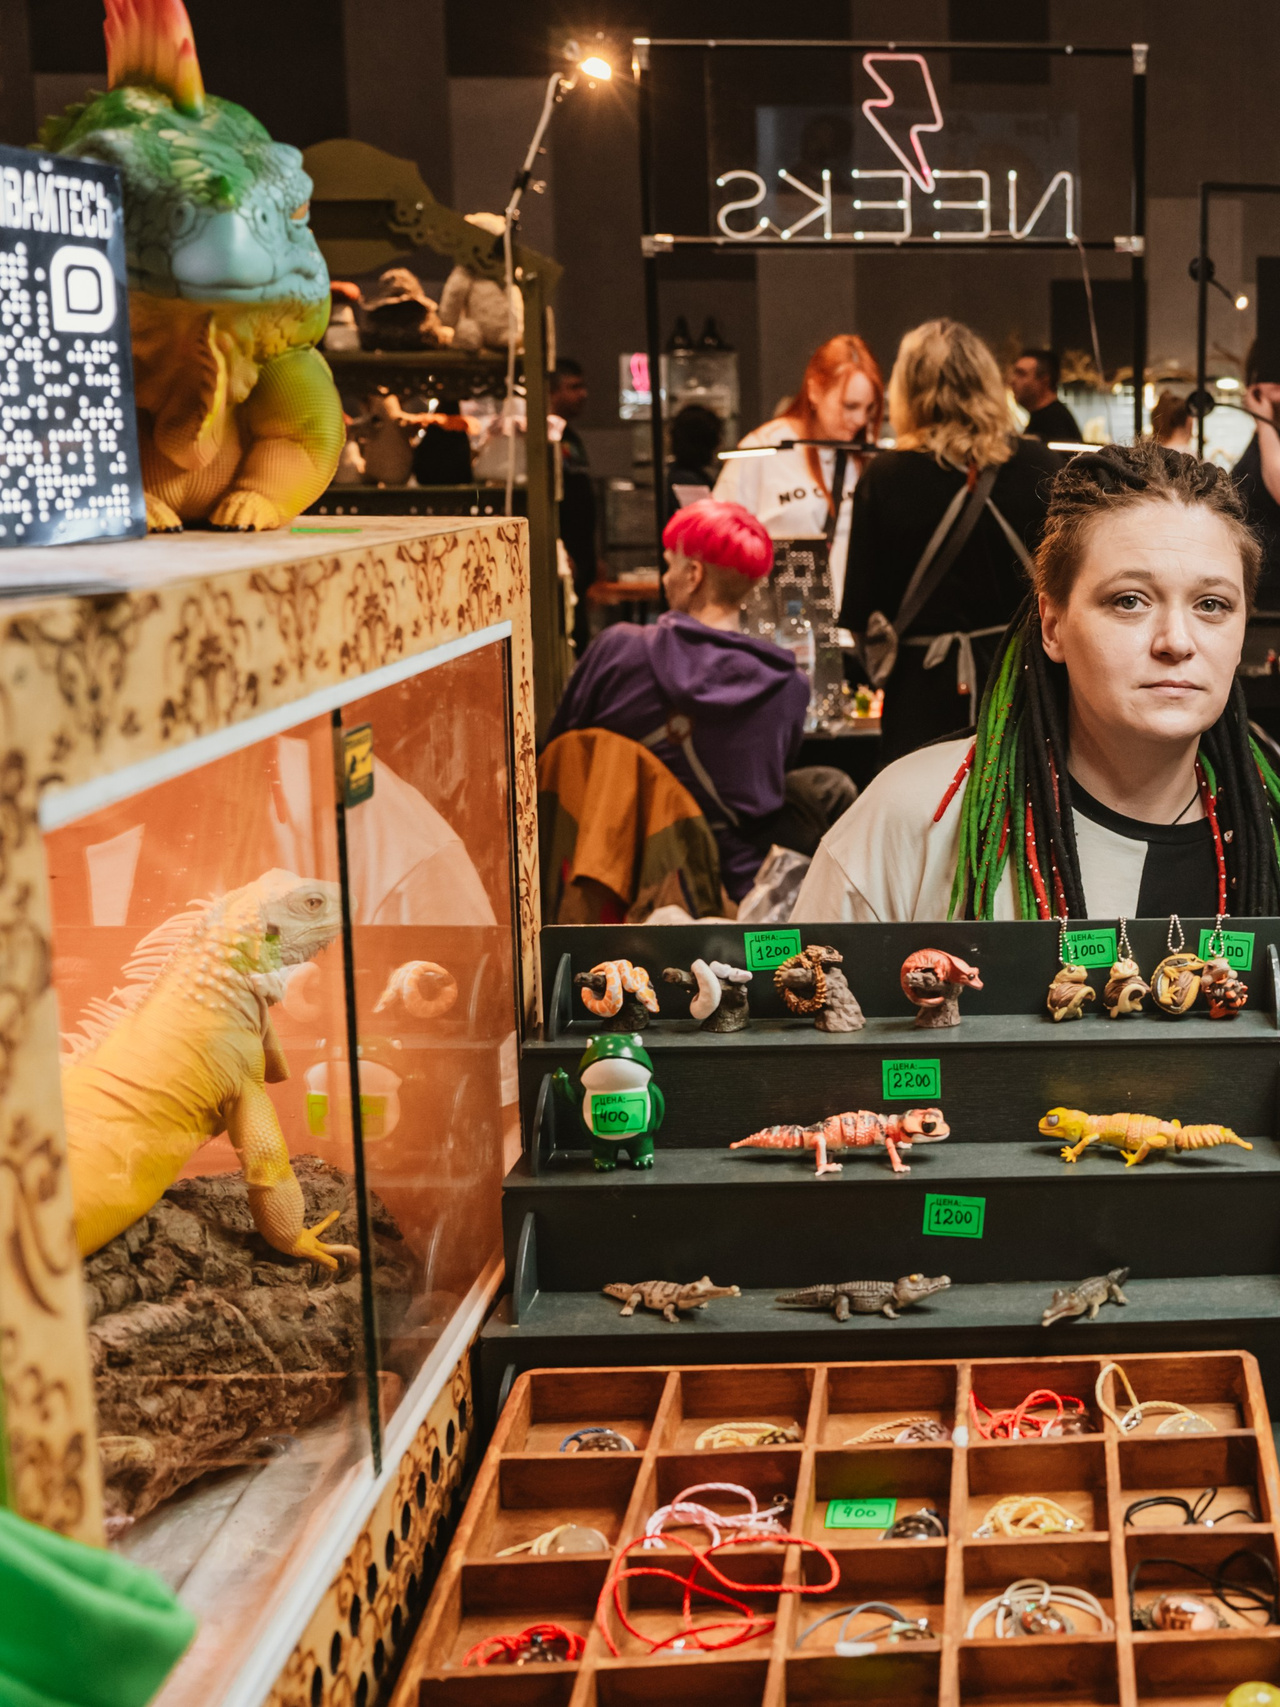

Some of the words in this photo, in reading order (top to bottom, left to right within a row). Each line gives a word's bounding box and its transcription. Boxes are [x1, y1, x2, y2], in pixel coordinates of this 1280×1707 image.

[779, 488, 806, 505] NO
[754, 934, 779, 943] ЦЕНА:
[1071, 934, 1095, 942] ЦЕНА:
[756, 945, 790, 961] 1200
[1073, 944, 1106, 960] 1000
[893, 1063, 918, 1071] ЦЕНА:
[893, 1072, 931, 1088] 2200
[600, 1096, 626, 1105] ЦЕНА:
[600, 1108, 629, 1123] 400
[934, 1208, 973, 1225] 1200
